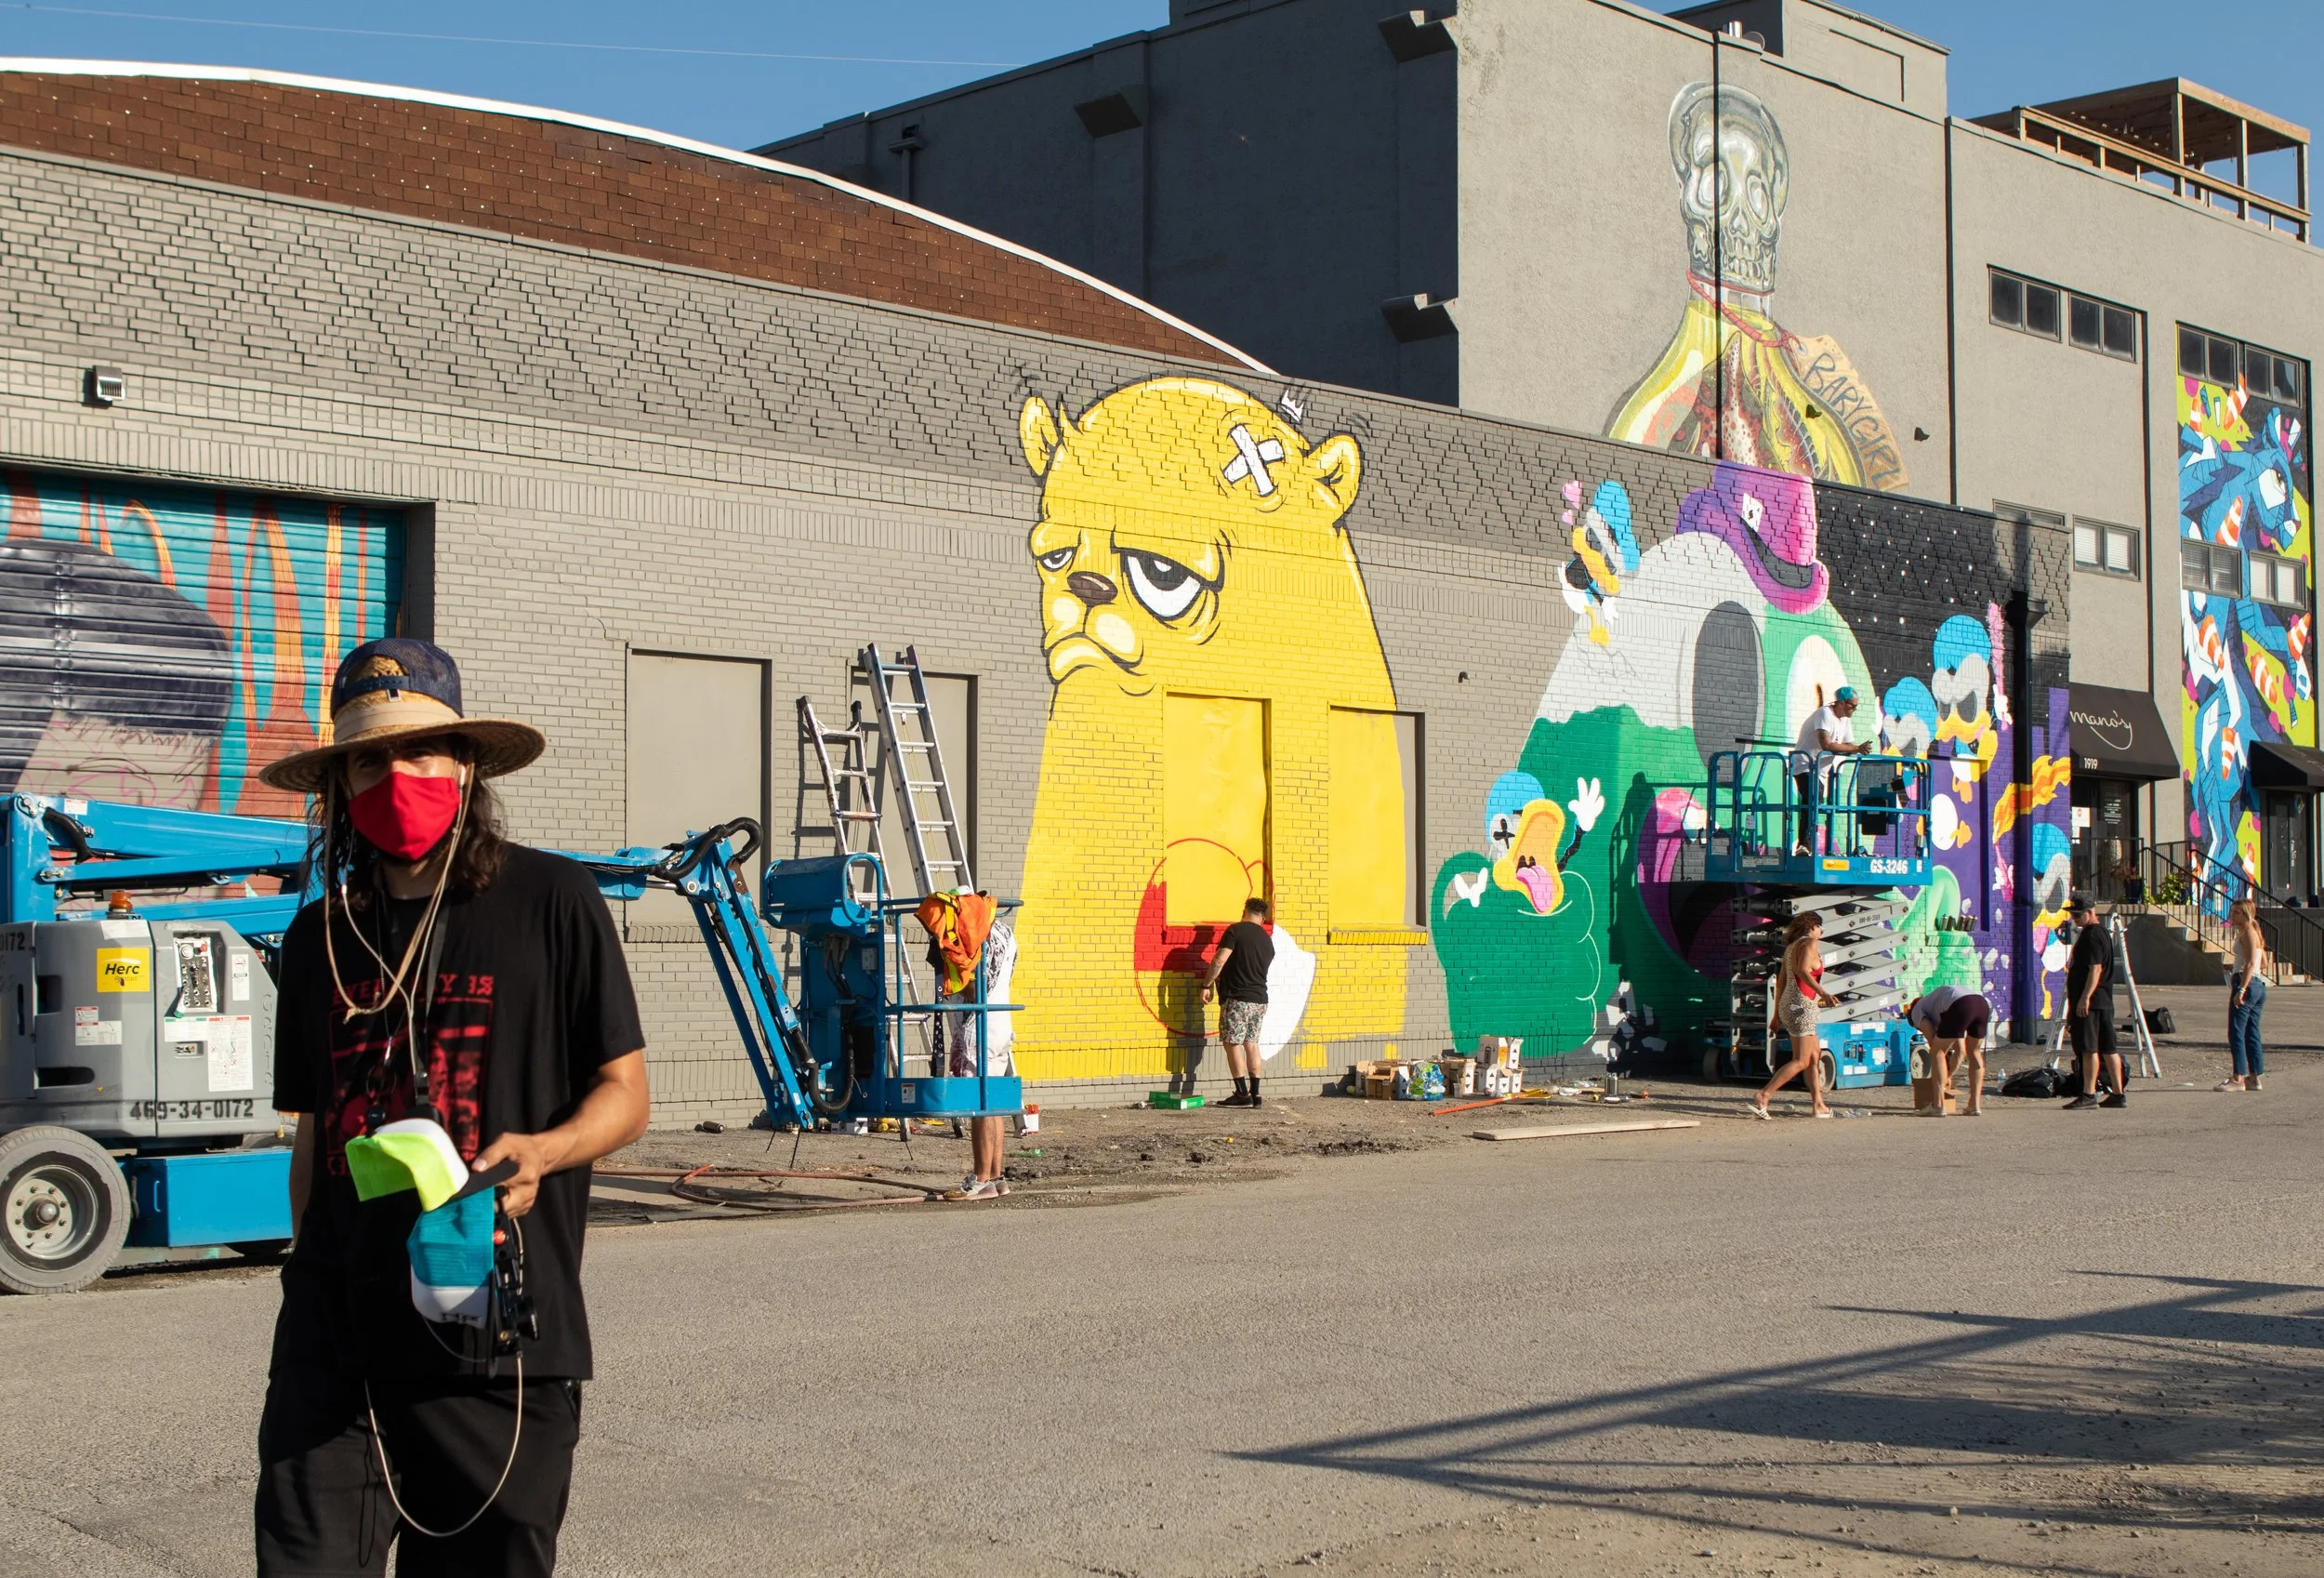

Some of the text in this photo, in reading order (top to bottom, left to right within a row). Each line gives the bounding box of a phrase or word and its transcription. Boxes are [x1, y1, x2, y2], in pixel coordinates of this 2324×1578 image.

[1802, 352, 1900, 489] BABYGIRL
[2084, 758, 2098, 770] 1919
[1870, 859, 1908, 874] GS-3246
[105, 963, 139, 975] Herc
[129, 1098, 254, 1120] 469-34-0172
